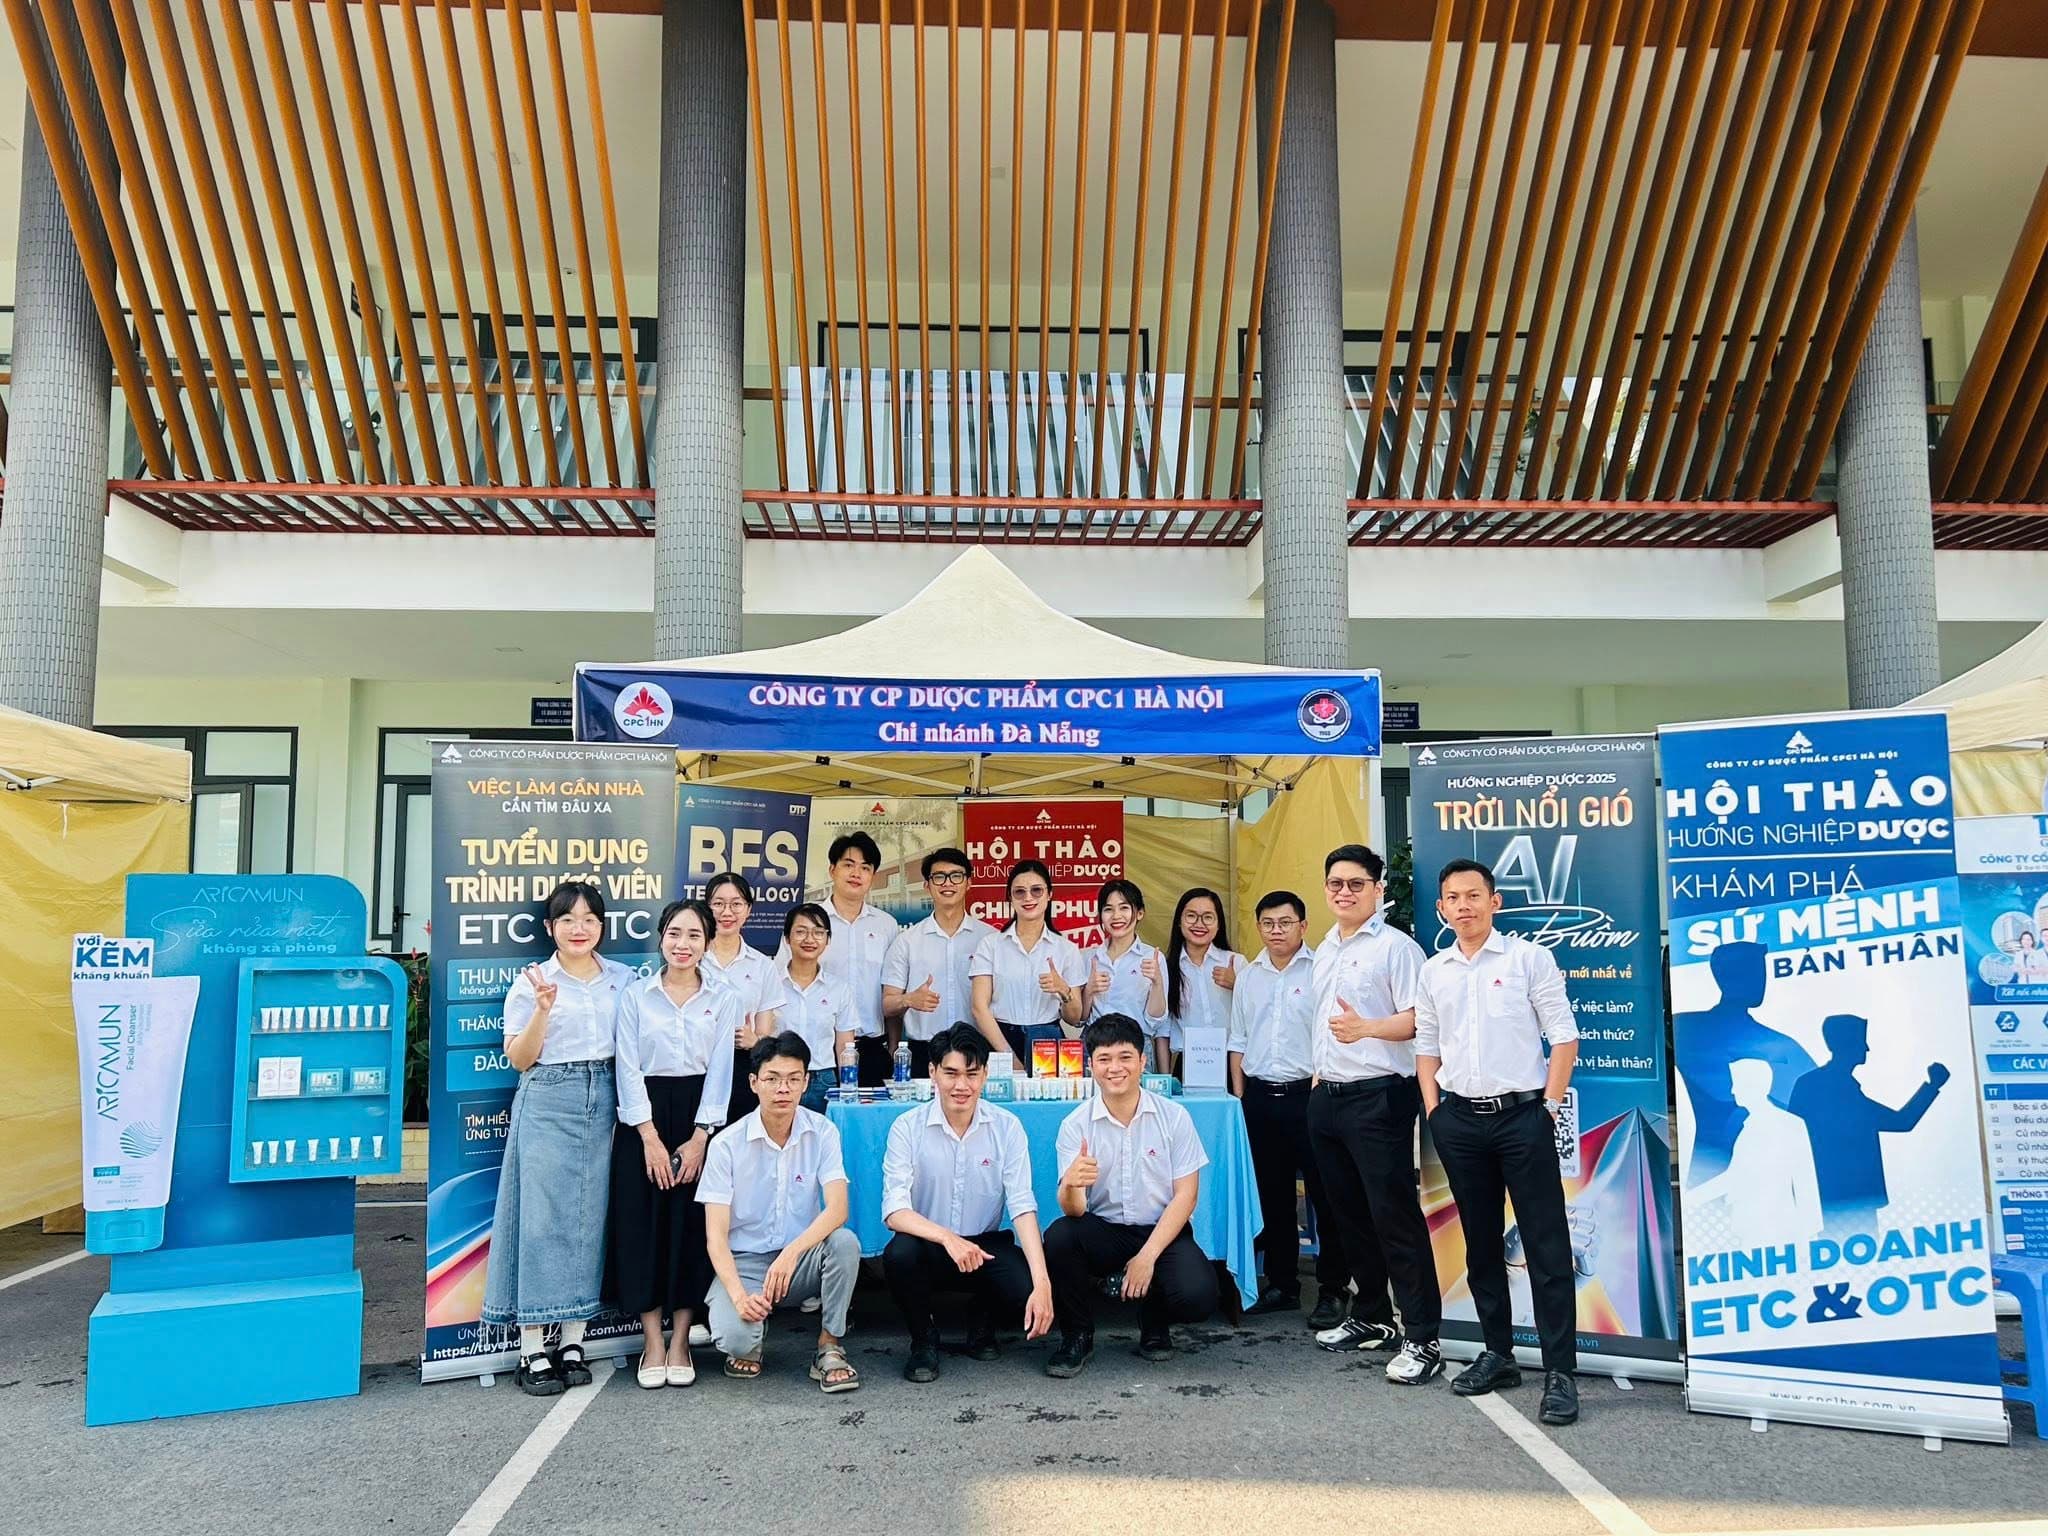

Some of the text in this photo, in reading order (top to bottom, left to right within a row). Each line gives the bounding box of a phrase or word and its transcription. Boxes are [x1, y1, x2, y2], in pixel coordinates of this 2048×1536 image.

[748, 679, 1224, 713] CÔNG TY CP DƯỢC PHẨM CPC1 HÀ NỘI
[623, 716, 664, 727] CPC1HN
[878, 720, 1100, 747] Chi nhánh Đà Nẵng
[1706, 760, 1733, 769] CÔNG
[1736, 760, 1749, 768] TY
[1752, 759, 1765, 767] CP
[467, 777, 645, 798] VIỆC LÀM GẦN NHÀ
[1447, 773, 1617, 789] HƯỚNG NGHIỆP DƯỢC 2025
[534, 797, 558, 813] TÌM
[562, 800, 590, 813] ĐÂU
[593, 801, 612, 813] XA
[789, 804, 807, 816] DTP
[1432, 785, 1634, 831] TRỜI NỔI GIÓ
[1666, 768, 1948, 825] HỘI THẢO
[1668, 818, 1950, 848] HƯỚNG NGHIỆP DƯỢC
[461, 827, 649, 872] TUYỂN DỤNG
[688, 825, 800, 887] BFS
[966, 834, 1122, 864] HỘI THẢO
[2015, 854, 2030, 863] TY
[1490, 834, 1579, 905] AI
[1671, 863, 1865, 899] KHÁM PHÁ
[445, 867, 662, 903] TRÌNH VIÊN
[459, 913, 536, 945] ETC
[1687, 886, 1941, 956] SỨ MỆNH
[77, 935, 101, 946] với
[203, 943, 257, 955] không
[285, 943, 337, 955] phòng
[76, 941, 150, 968] KẼM
[1773, 932, 1959, 979] BẢN THÂN
[457, 968, 494, 986] THU
[1569, 966, 1590, 979] mới
[1592, 963, 1617, 979] nhất
[1619, 963, 1633, 979] về
[1581, 1000, 1634, 1016] việc làm?
[126, 1003, 138, 1071] Facial Cleanser
[1603, 1028, 1635, 1041] thức?
[1585, 1055, 1595, 1071] vị
[1597, 1055, 1619, 1068] bản
[1621, 1056, 1653, 1069] thân?
[2013, 1055, 2036, 1071] CÁC
[464, 1113, 485, 1128] TÌM
[465, 1127, 491, 1141] ỨNG
[1687, 1218, 1984, 1286] KINH DOANH
[1691, 1266, 1990, 1338] ETC & OTC
